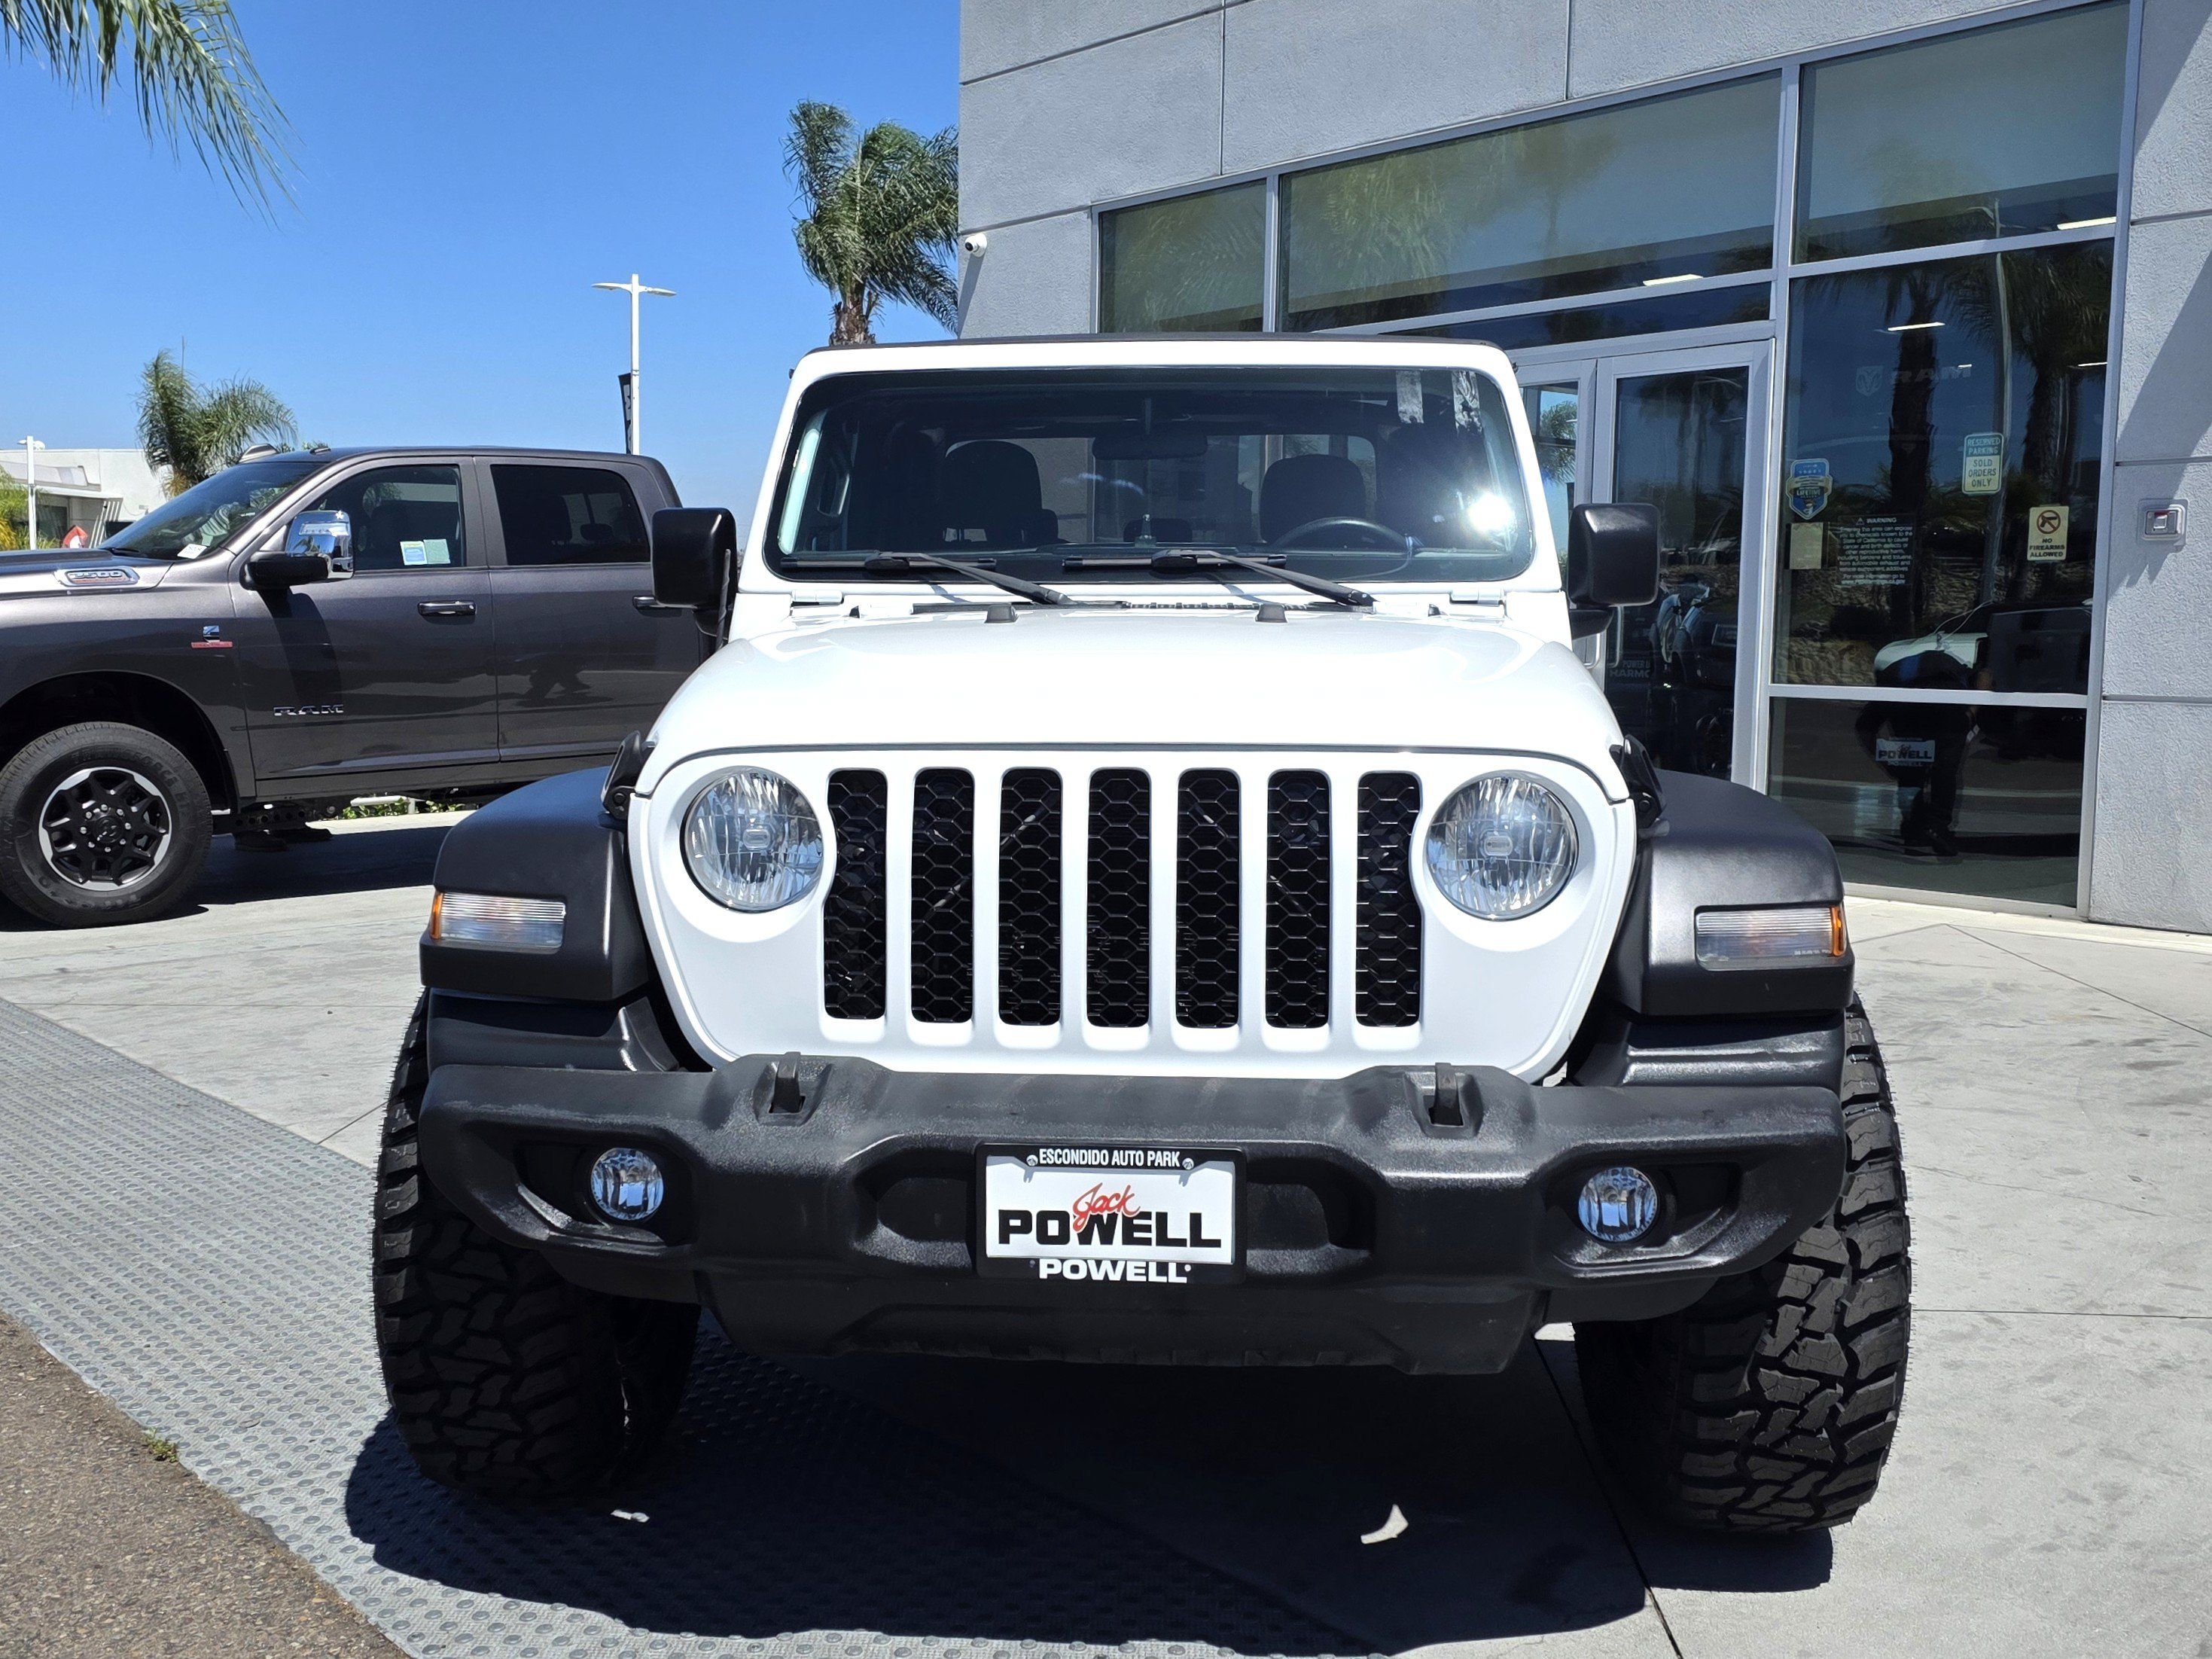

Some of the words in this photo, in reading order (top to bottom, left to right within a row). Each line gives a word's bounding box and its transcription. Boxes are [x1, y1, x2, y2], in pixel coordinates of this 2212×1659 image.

[1967, 438, 2000, 446] RESERVED
[1969, 447, 1998, 455] PARKING
[1968, 468, 1997, 477] ORDERS
[1972, 479, 1991, 487] ONLY
[273, 704, 344, 716] RAM
[1878, 750, 1932, 759] POWELL
[1039, 1148, 1108, 1166] ESCONDIDO
[1111, 1150, 1144, 1166] AUTO
[1147, 1151, 1180, 1167] PARK
[1073, 1182, 1141, 1233] Jack
[998, 1209, 1221, 1248] POWELL
[1039, 1258, 1187, 1283] POWELL
